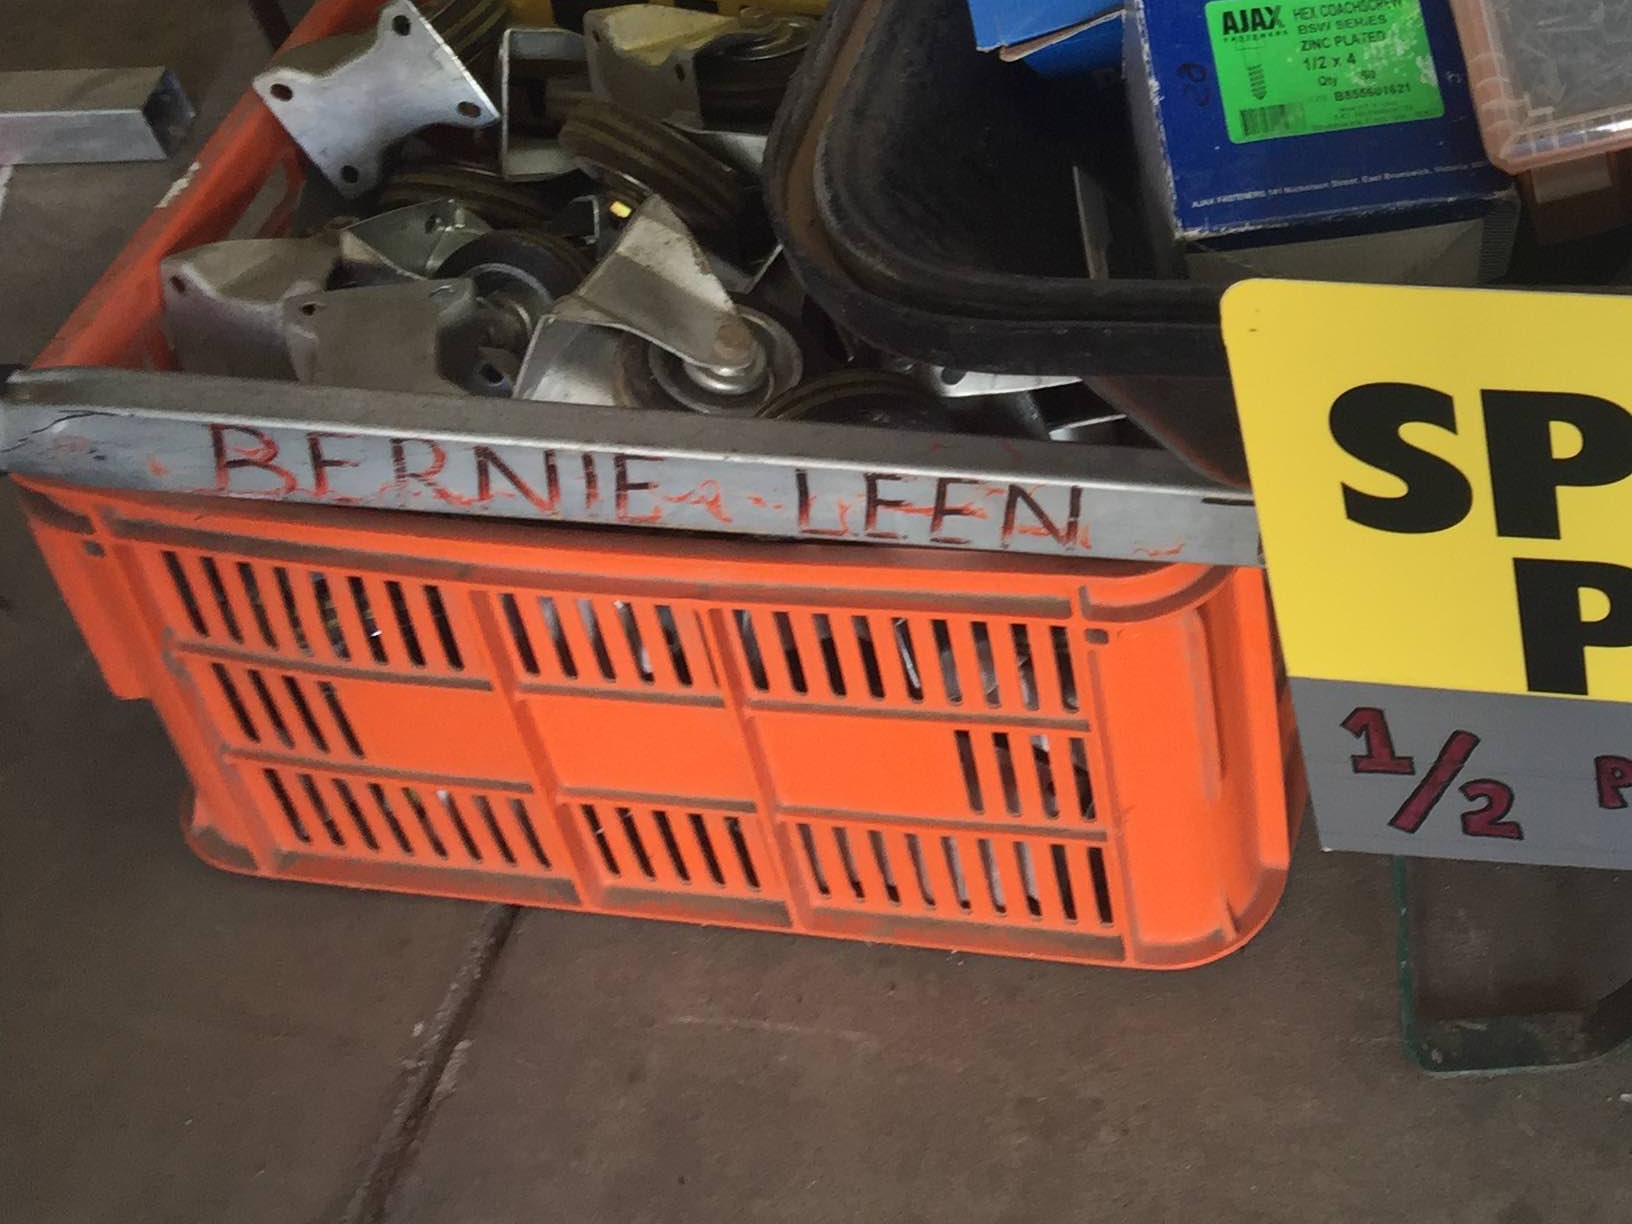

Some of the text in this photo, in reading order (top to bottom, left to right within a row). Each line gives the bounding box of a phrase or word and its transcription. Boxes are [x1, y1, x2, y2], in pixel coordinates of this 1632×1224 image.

[1221, 4, 1286, 37] AJAX
[1301, 30, 1387, 52] ZINC PLATED
[1303, 55, 1328, 72] 1/2
[1338, 705, 1524, 842] 1/2
